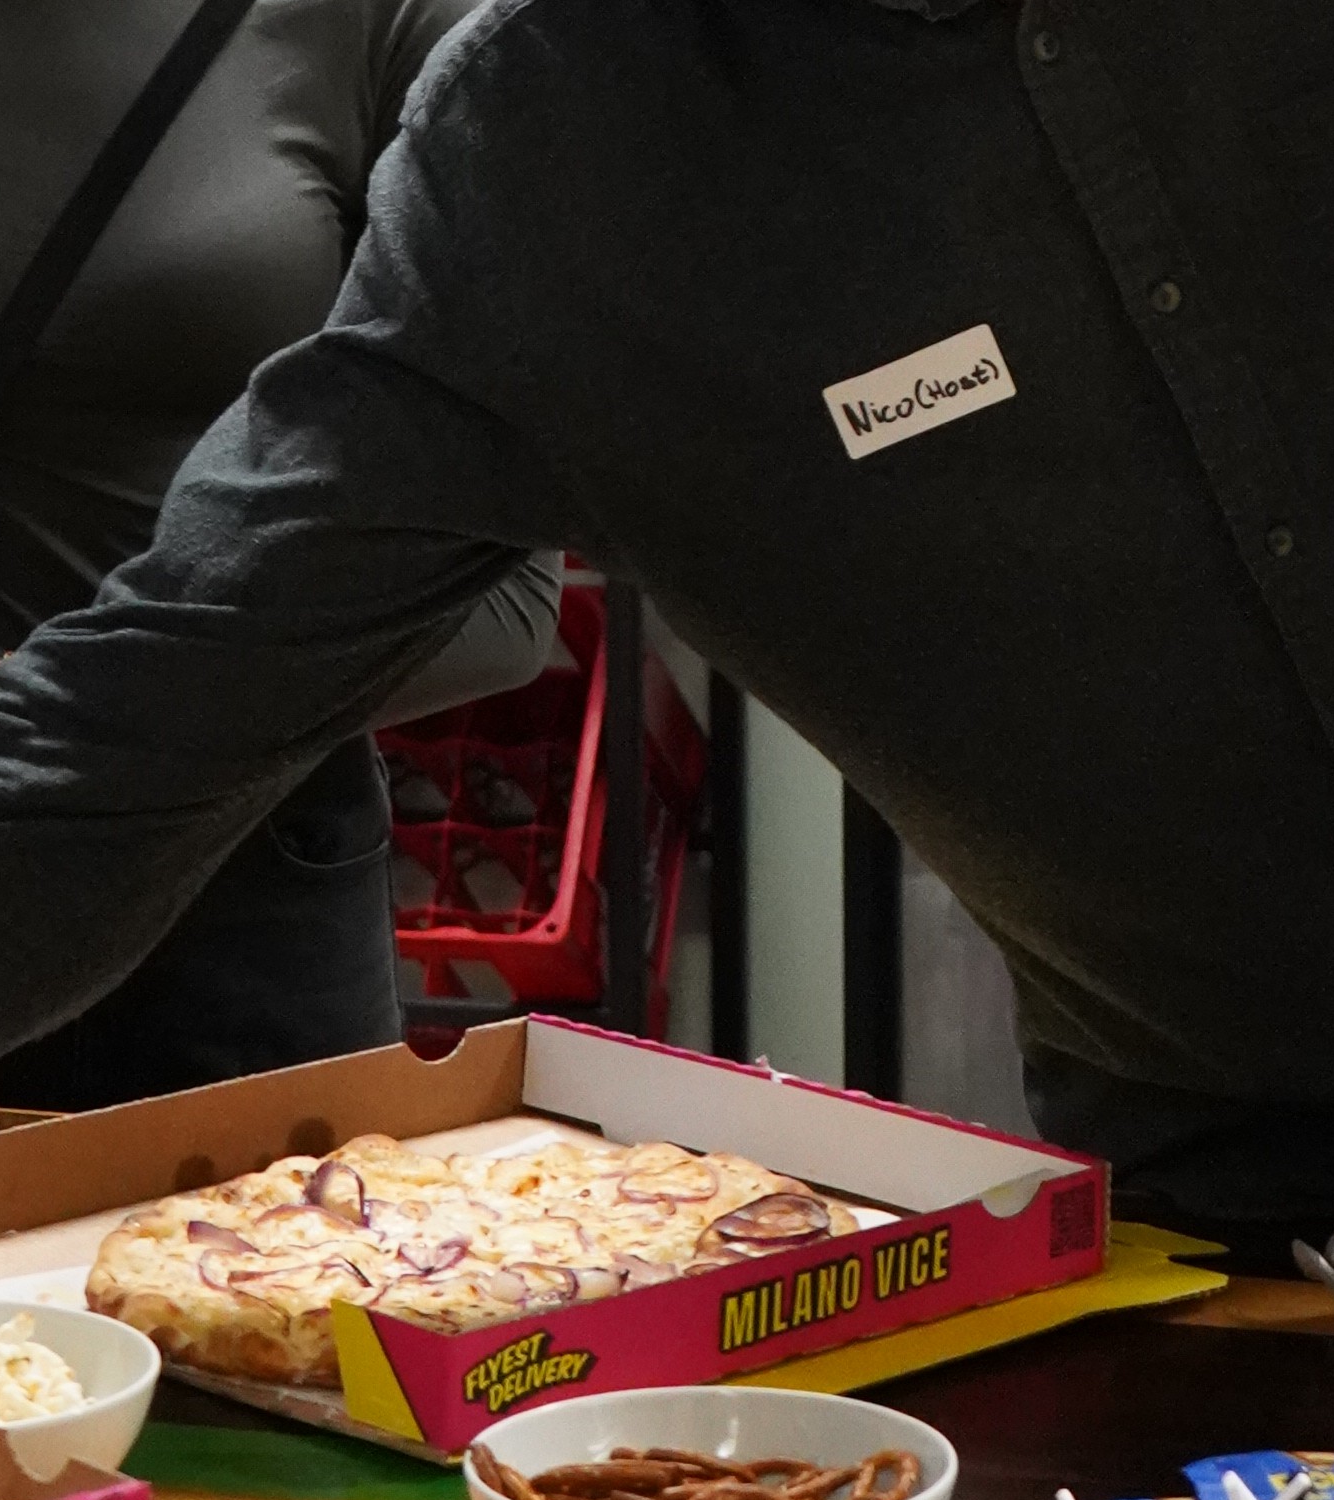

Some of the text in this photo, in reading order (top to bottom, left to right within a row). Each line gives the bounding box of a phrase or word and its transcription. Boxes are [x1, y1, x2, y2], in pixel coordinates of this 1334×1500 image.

[723, 1229, 949, 1351] MILANO VICE
[465, 1332, 546, 1400] FLYEST
[489, 1352, 590, 1412] DELIVERY
